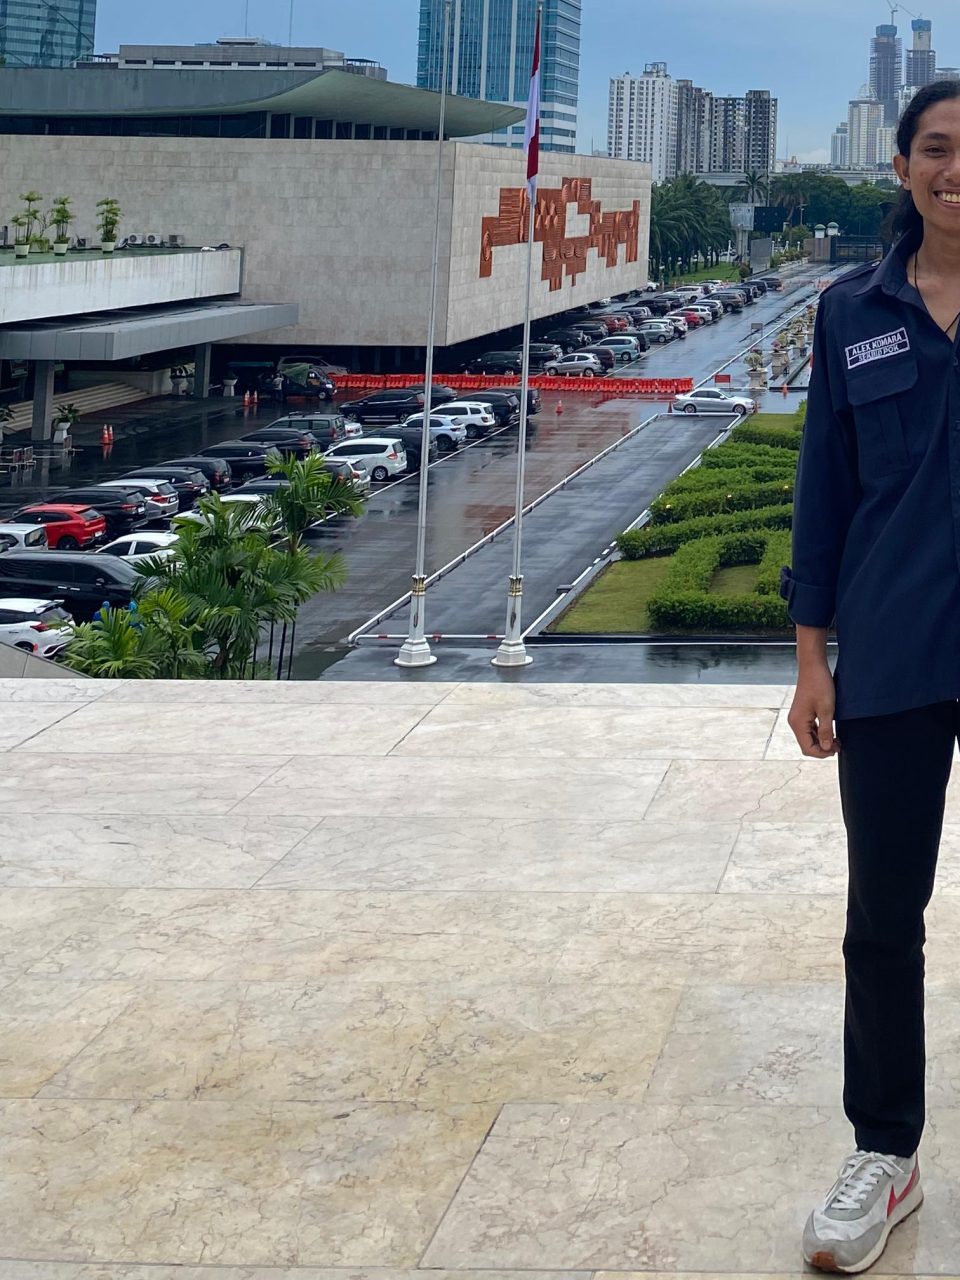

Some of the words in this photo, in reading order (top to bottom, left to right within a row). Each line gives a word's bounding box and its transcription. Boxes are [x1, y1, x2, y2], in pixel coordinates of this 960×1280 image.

[852, 343, 871, 356] ALEX
[872, 332, 903, 349] KOMARA
[883, 344, 899, 355] POK
